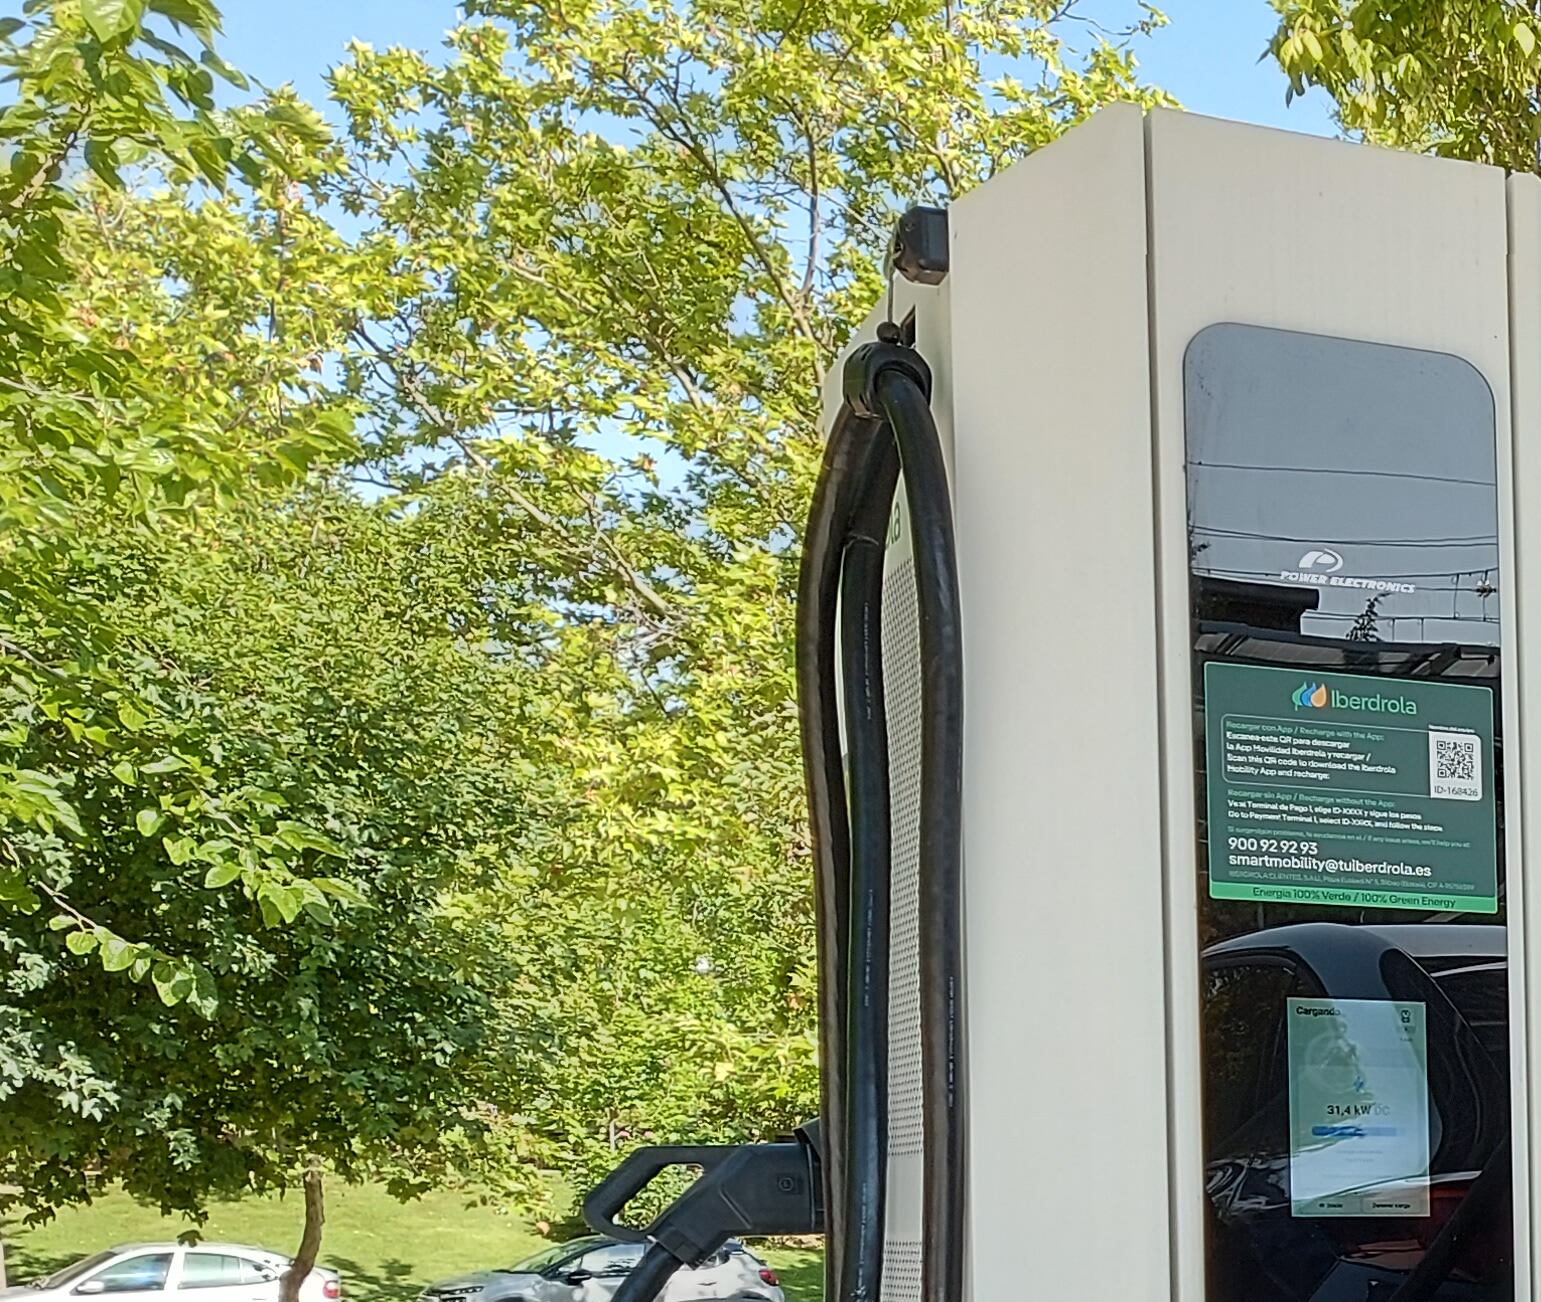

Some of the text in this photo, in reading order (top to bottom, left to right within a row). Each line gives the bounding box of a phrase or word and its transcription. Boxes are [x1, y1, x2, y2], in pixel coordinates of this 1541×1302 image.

[1280, 571, 1416, 593] POWER ELECTRONICS
[1331, 689, 1417, 715] Iberdrola
[1279, 736, 1291, 744] QR
[1236, 743, 1252, 752] App
[1227, 753, 1247, 762] Scan
[1264, 756, 1276, 765] QR
[1278, 757, 1297, 766] code
[1299, 759, 1307, 767] to
[1308, 760, 1346, 770] download
[1348, 763, 1360, 771] the
[1227, 765, 1259, 775] Mobility
[1260, 767, 1276, 776] App
[1278, 769, 1292, 777] and
[1276, 792, 1293, 801] App
[1247, 801, 1278, 810] Terminal
[1290, 804, 1308, 813] Pago
[1228, 810, 1240, 818] Go
[1228, 837, 1318, 855] 900 92 92 93
[1293, 888, 1320, 900] 100%
[1322, 891, 1351, 901] Verde
[1361, 893, 1387, 904] 100%
[1389, 895, 1420, 905] Green
[1421, 896, 1456, 908] Energy
[1327, 1105, 1351, 1117] 31,4
[1354, 1104, 1372, 1115] kW
